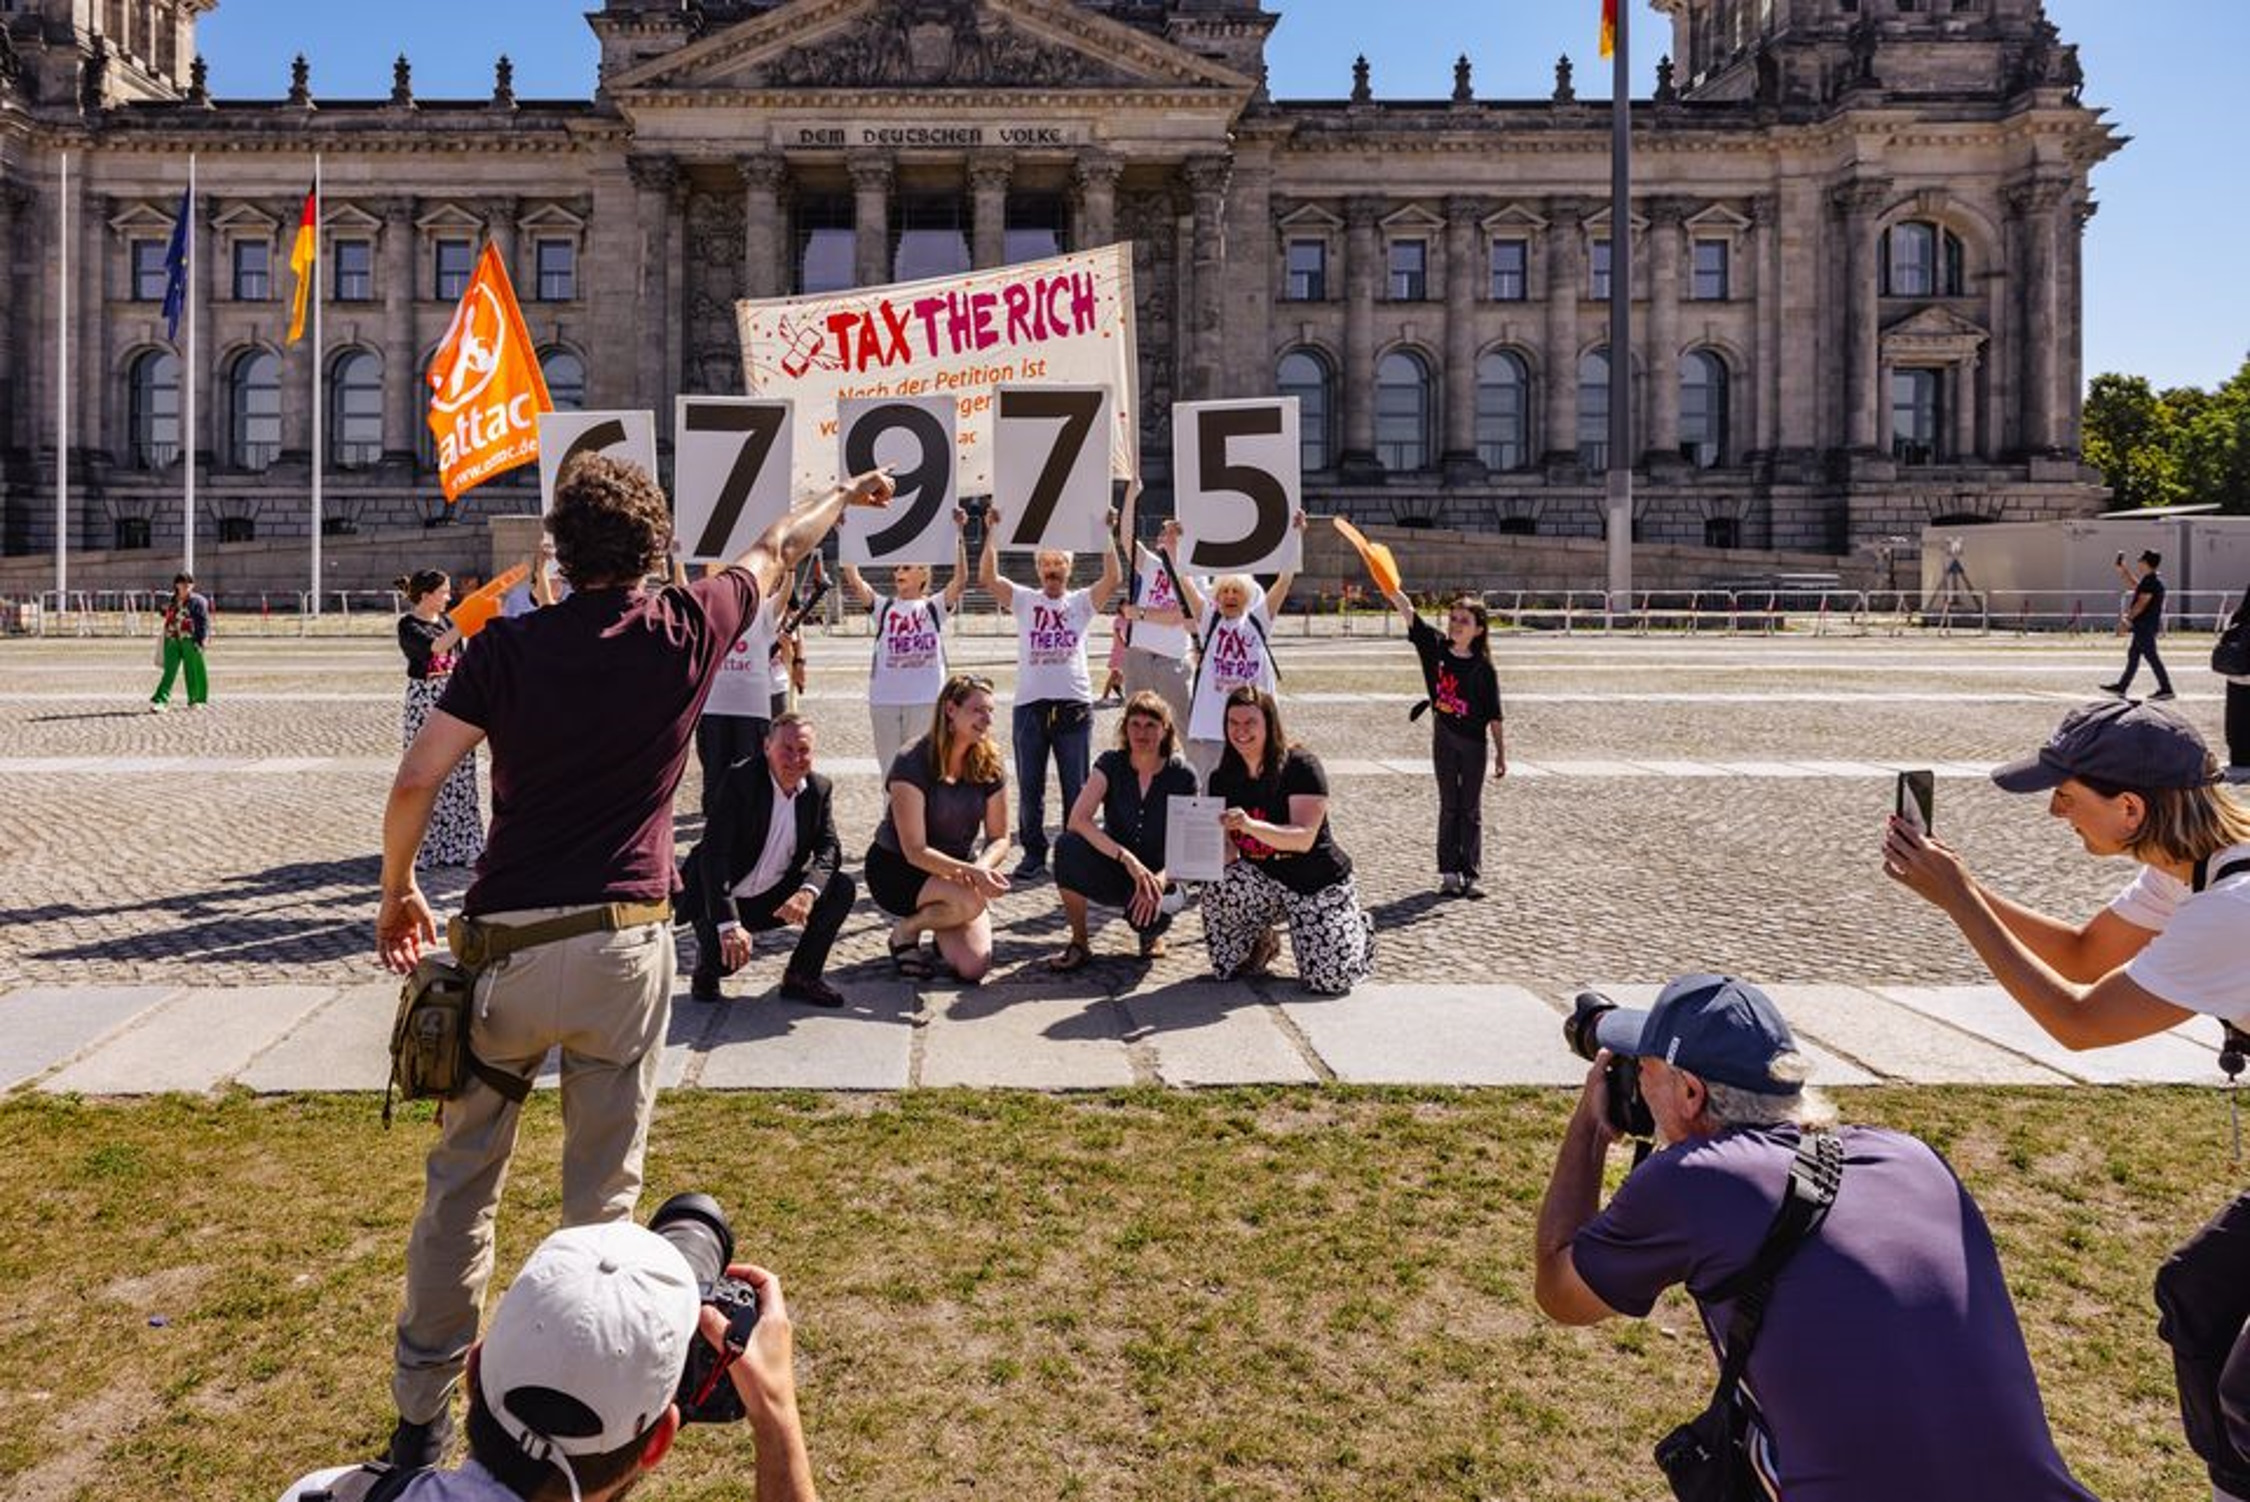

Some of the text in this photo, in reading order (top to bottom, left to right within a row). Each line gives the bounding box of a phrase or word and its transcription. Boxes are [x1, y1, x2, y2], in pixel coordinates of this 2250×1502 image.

[799, 127, 1062, 144] DEM DEUTSCHEN VOLKE
[827, 299, 912, 373] TAX
[1005, 271, 1096, 346] RICH
[935, 364, 1014, 391] Petition
[1021, 359, 1047, 378] ist
[439, 392, 532, 471] attac
[686, 404, 787, 558] 7
[845, 403, 951, 560] 9
[1000, 391, 1104, 545] 7
[1190, 406, 1290, 569] 5
